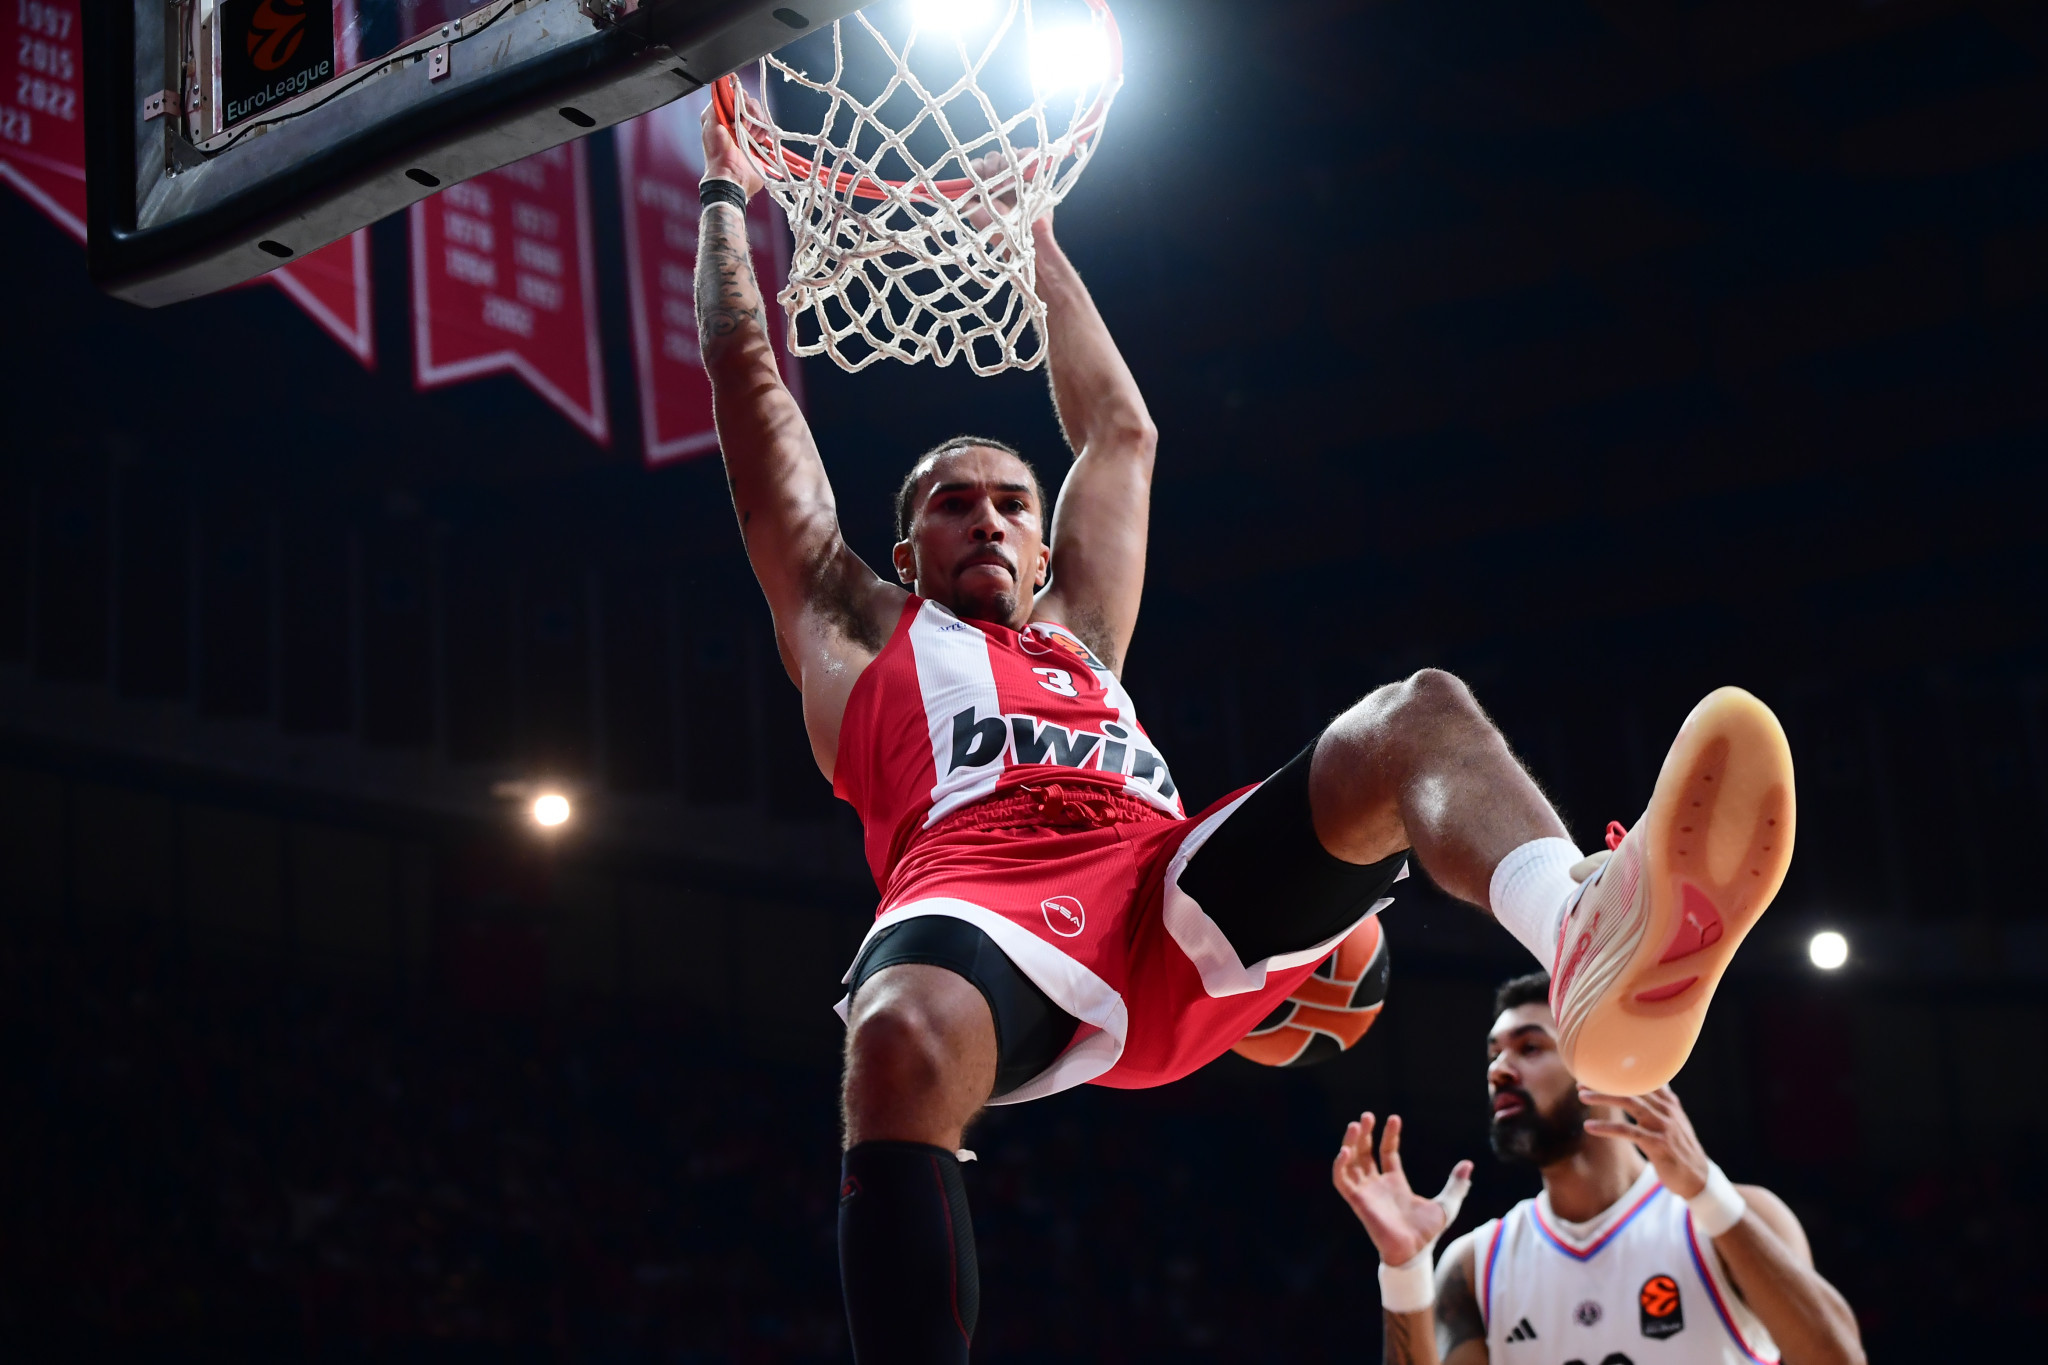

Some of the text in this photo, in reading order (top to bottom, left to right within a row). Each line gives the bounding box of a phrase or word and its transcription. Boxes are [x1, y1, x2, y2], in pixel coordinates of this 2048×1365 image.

[227, 60, 329, 121] EuroLeague
[1031, 667, 1080, 698] 3
[948, 705, 1178, 800] bwin
